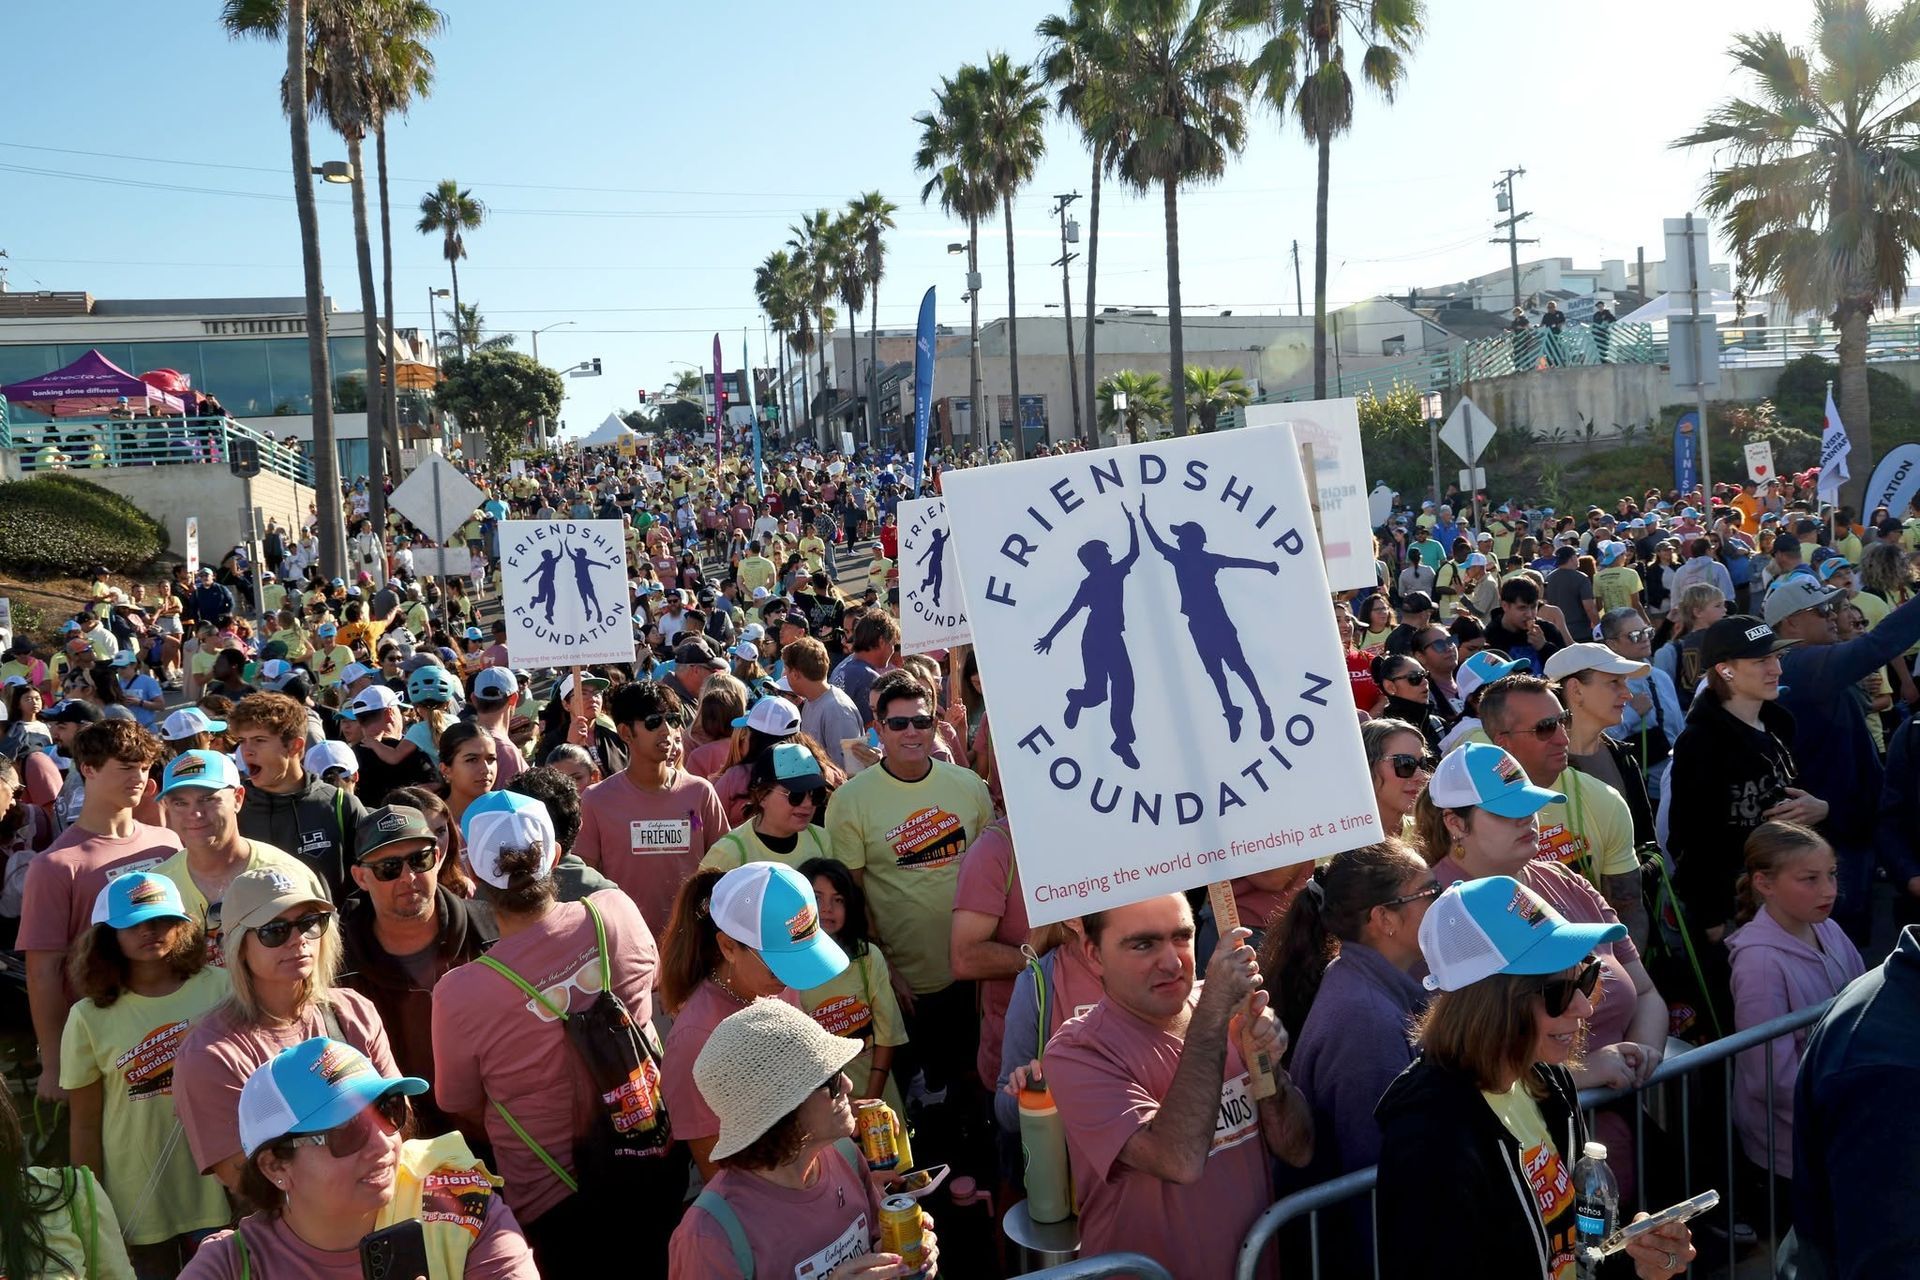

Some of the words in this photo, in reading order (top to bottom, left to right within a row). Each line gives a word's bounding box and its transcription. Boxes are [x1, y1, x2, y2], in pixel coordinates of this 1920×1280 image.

[1824, 431, 1844, 449] VISTA
[985, 453, 1304, 608] FRIENDSHIP
[507, 523, 621, 568] FRIENDSHIP
[513, 602, 625, 646] FOUNDATION
[581, 652, 609, 660] friendship
[1017, 671, 1333, 826] FOUNDATION
[648, 821, 675, 830] California
[886, 806, 939, 841] SKECHERS
[905, 829, 917, 838] Pier
[922, 820, 932, 829] Pier
[302, 831, 323, 843] LA
[641, 829, 683, 845] FRIENDS
[896, 826, 939, 853] Friendship
[938, 815, 958, 830] Walk
[1034, 874, 1110, 903] Changing
[1113, 867, 1140, 886] the
[1144, 852, 1192, 877] world
[1196, 848, 1226, 865] one
[1230, 828, 1305, 858] friendship
[1309, 822, 1325, 838] at
[1328, 822, 1337, 834] a
[1341, 812, 1374, 831] time
[267, 873, 296, 890] LA
[832, 1011, 846, 1020] Pier
[850, 1006, 870, 1022] Walk
[116, 1020, 188, 1069] SKECHERS
[140, 1050, 156, 1062] Pier
[163, 1037, 178, 1049] Pier
[861, 1110, 890, 1129] OLIPO
[1578, 1205, 1602, 1216] ethos
[824, 1234, 856, 1263] California
